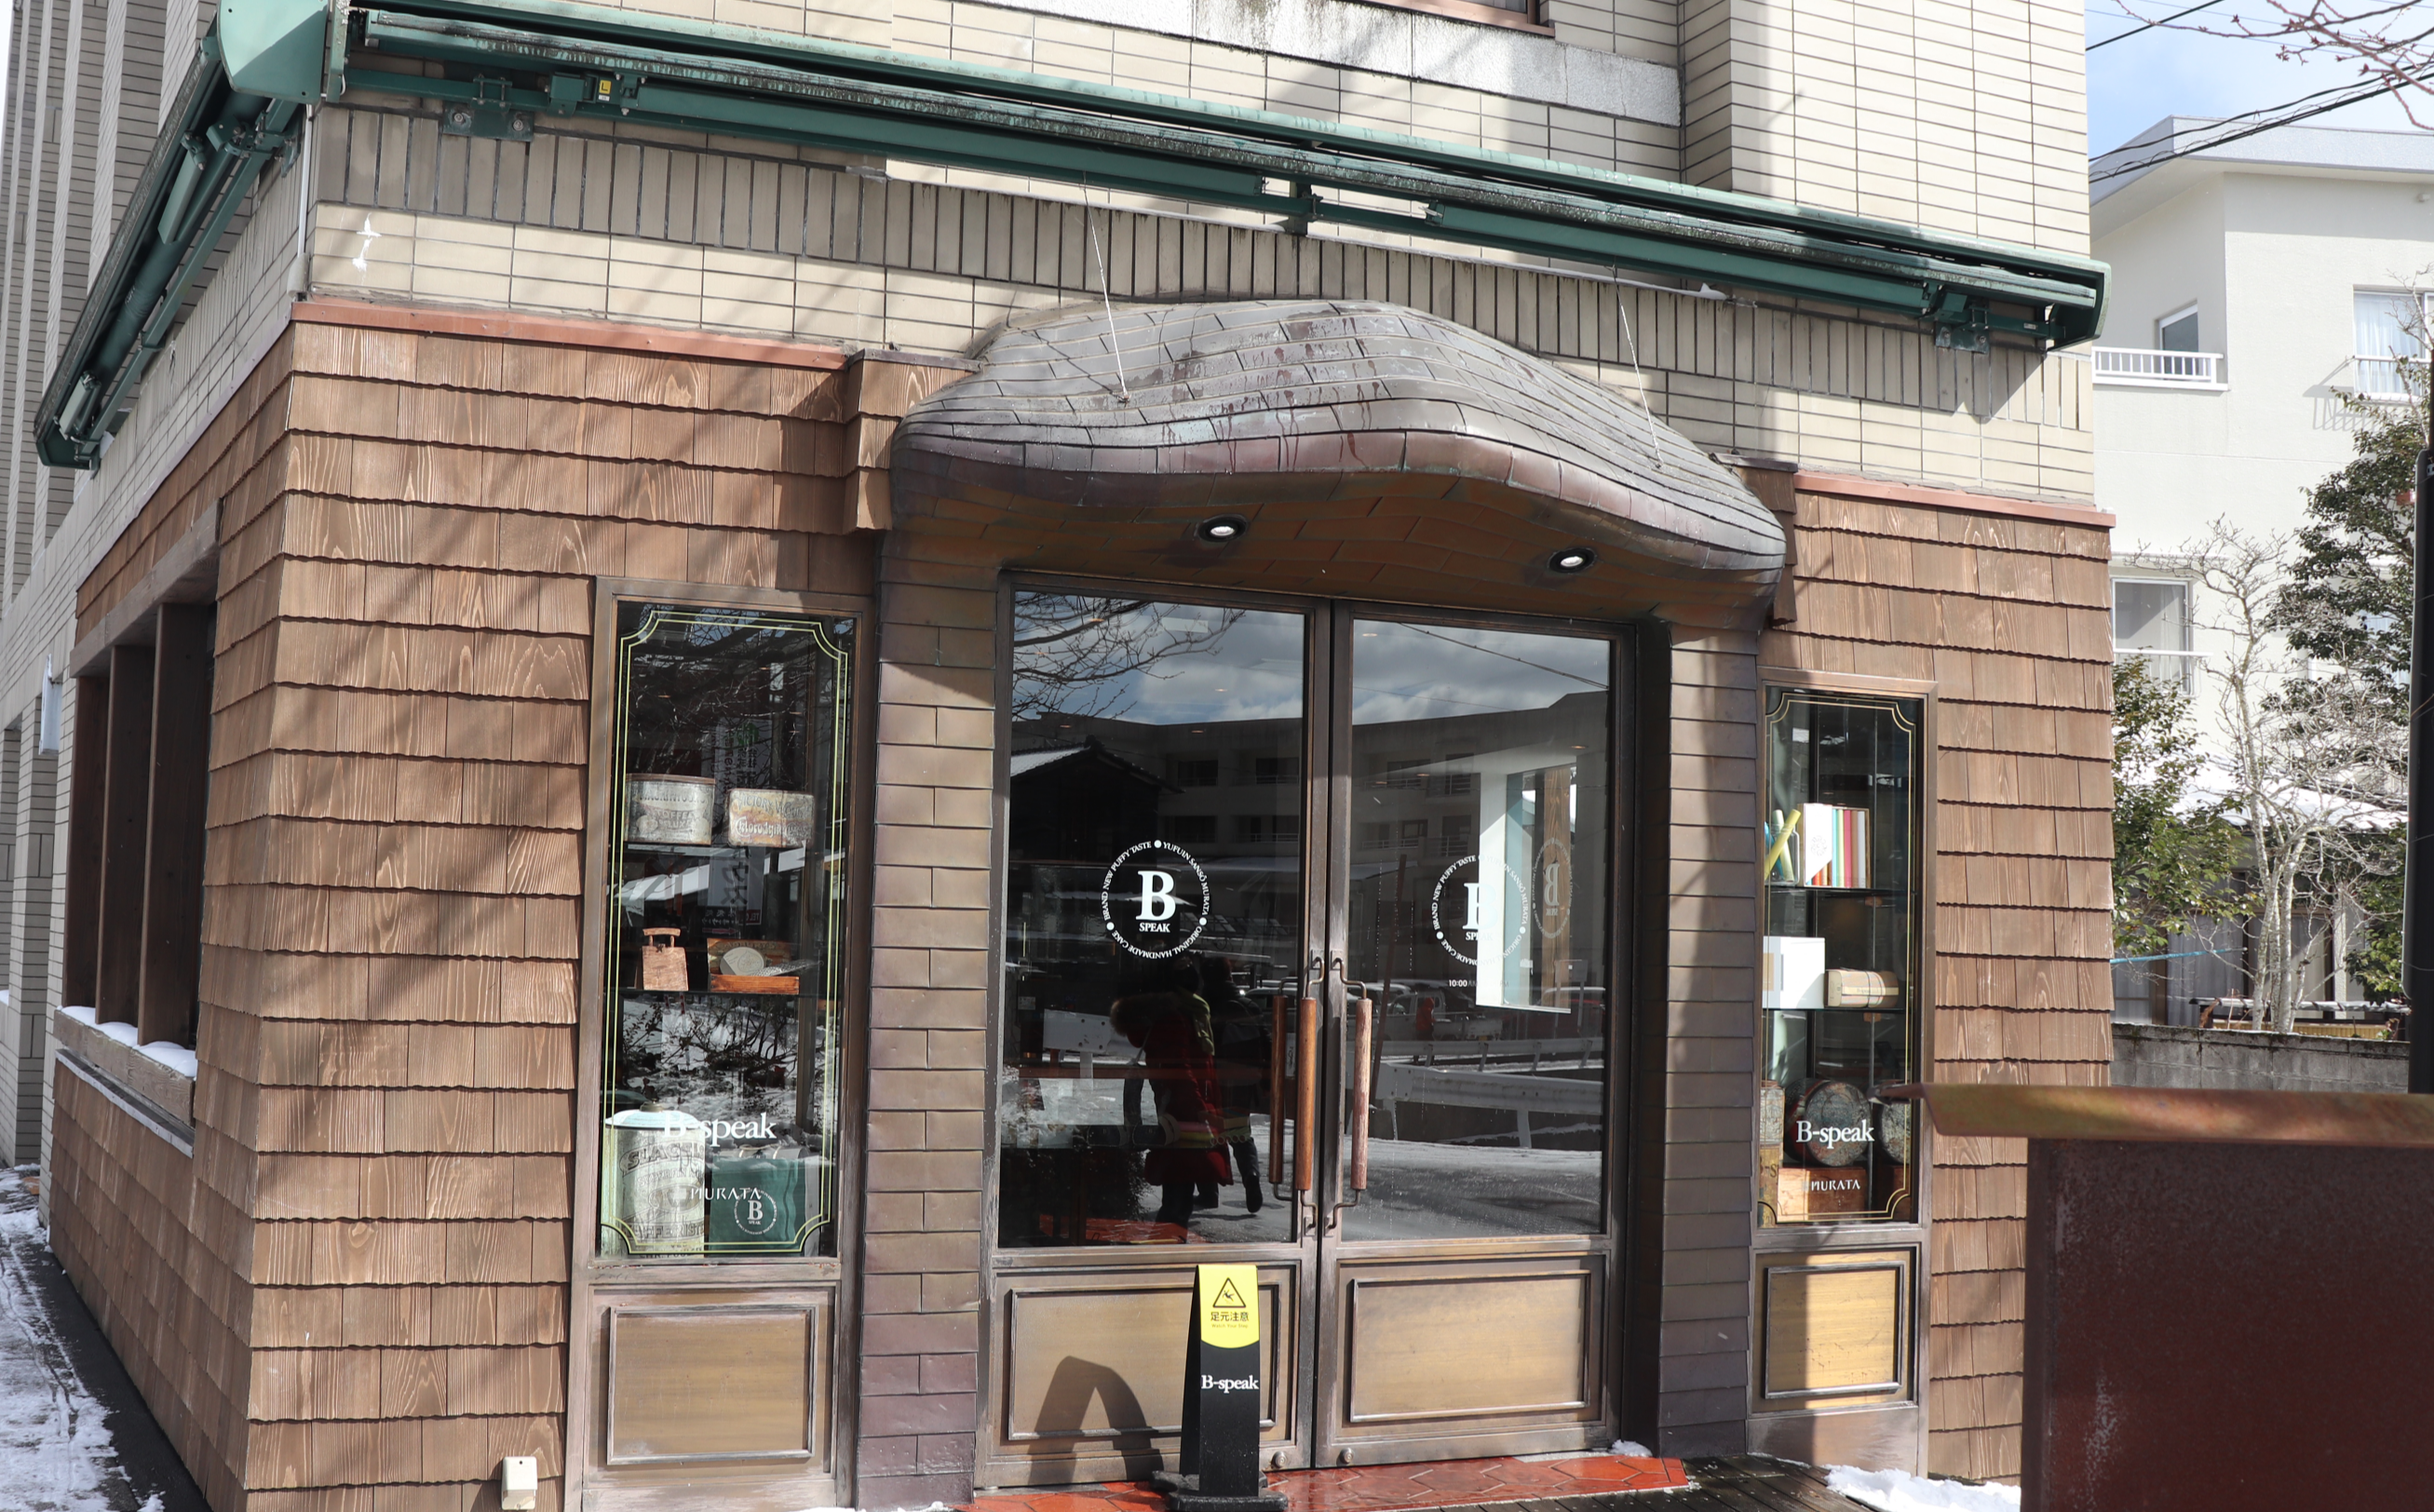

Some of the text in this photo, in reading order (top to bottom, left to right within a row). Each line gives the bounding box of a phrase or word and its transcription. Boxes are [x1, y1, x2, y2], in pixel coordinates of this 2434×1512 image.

[1101, 841, 1152, 921] BRAND NEW PUFFY TASTE
[1163, 842, 1191, 861] YUFUIN
[1200, 882, 1210, 915] MURATA
[1431, 855, 1477, 930] BRAND NEW PUFFY TASTE
[1135, 871, 1176, 921] B
[1462, 883, 1499, 930] B
[1520, 893, 1529, 925] MURATA
[1112, 925, 1202, 959] ORIGINAL HANDMADE CAKE
[1139, 923, 1170, 933] SPEAK
[1440, 938, 1456, 956] CAKE
[663, 1112, 777, 1147] B-speak
[1795, 1119, 1875, 1150] B-speak
[691, 1187, 762, 1200] MURATA
[1811, 1179, 1860, 1192] MURATA
[747, 1200, 764, 1220] B
[1210, 1312, 1249, 1322] 足元注意
[1201, 1375, 1259, 1394] B-speak
